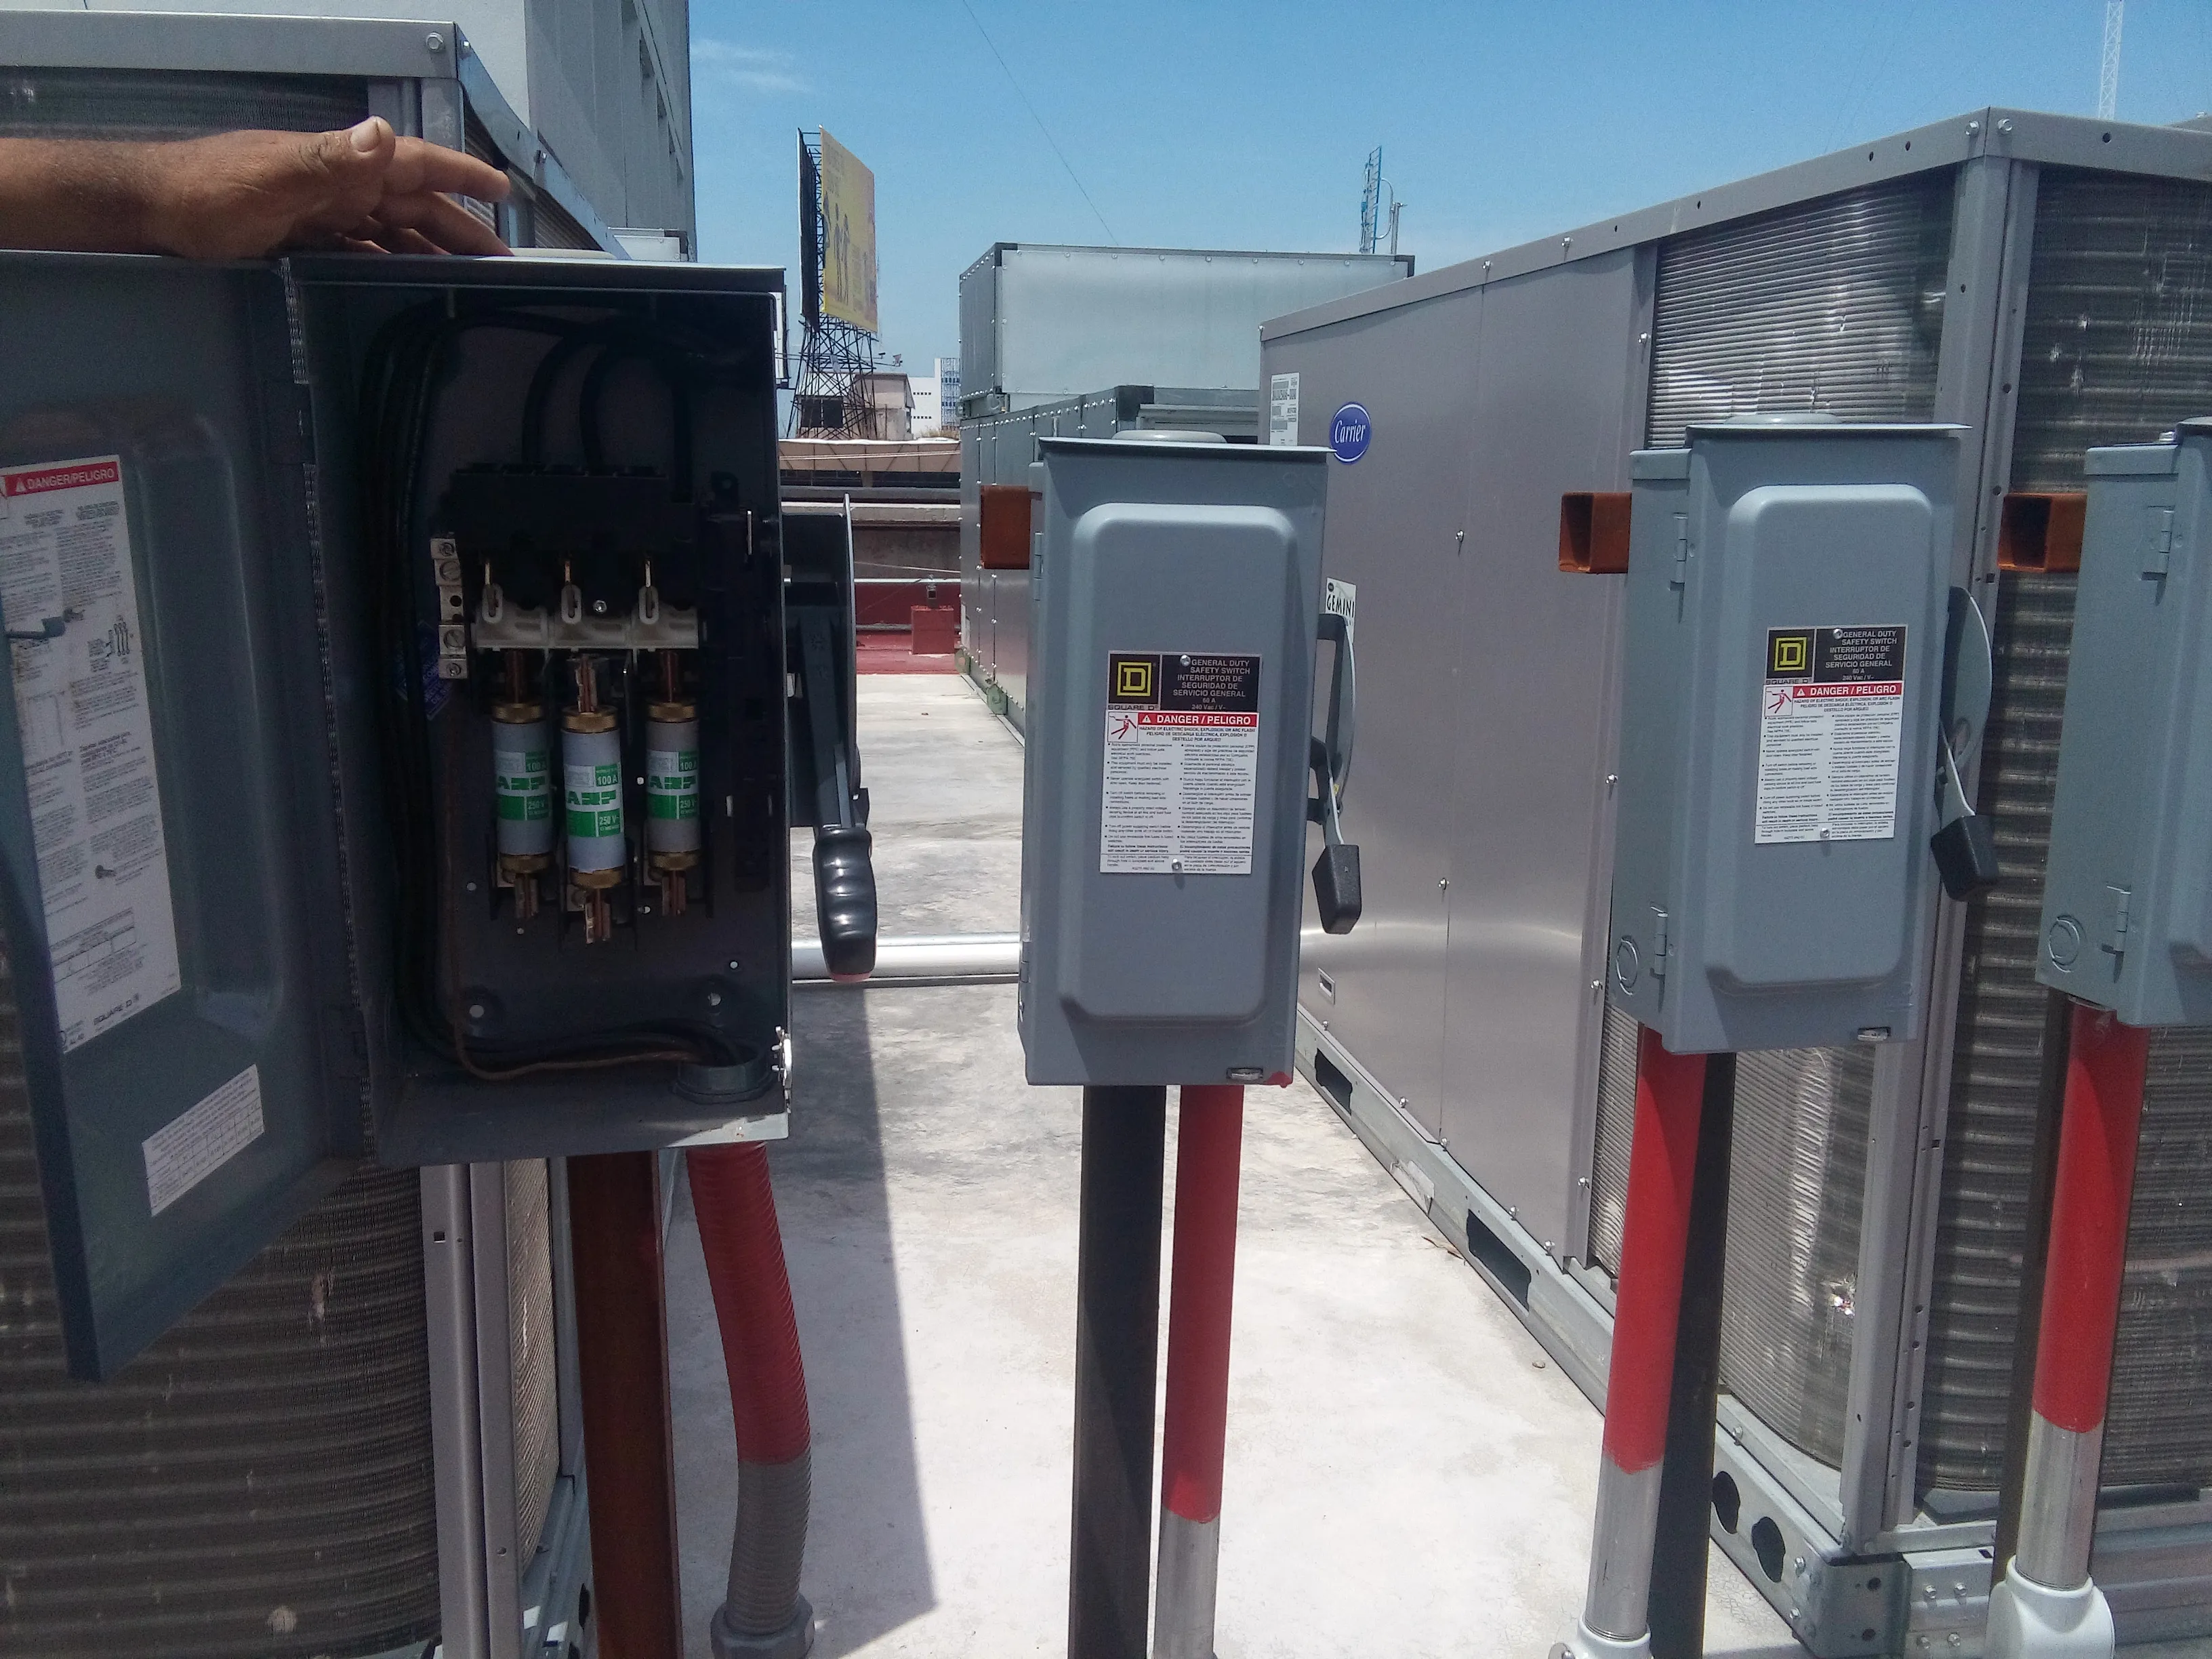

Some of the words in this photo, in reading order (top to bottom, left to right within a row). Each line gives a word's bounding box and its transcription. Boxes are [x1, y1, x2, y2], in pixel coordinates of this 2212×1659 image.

[1334, 419, 1366, 444] Carrier
[1327, 594, 1355, 618] GEMINI
[1810, 687, 1849, 696] DANGER
[1856, 685, 1896, 694] PELIGRO
[1157, 716, 1199, 724] DANGER
[1207, 716, 1251, 725] PELIGRO
[527, 762, 541, 771] 100
[680, 762, 693, 771] 100
[597, 775, 611, 785] 100
[613, 775, 618, 783] A
[680, 800, 691, 808] 250
[598, 816, 610, 825] 250
